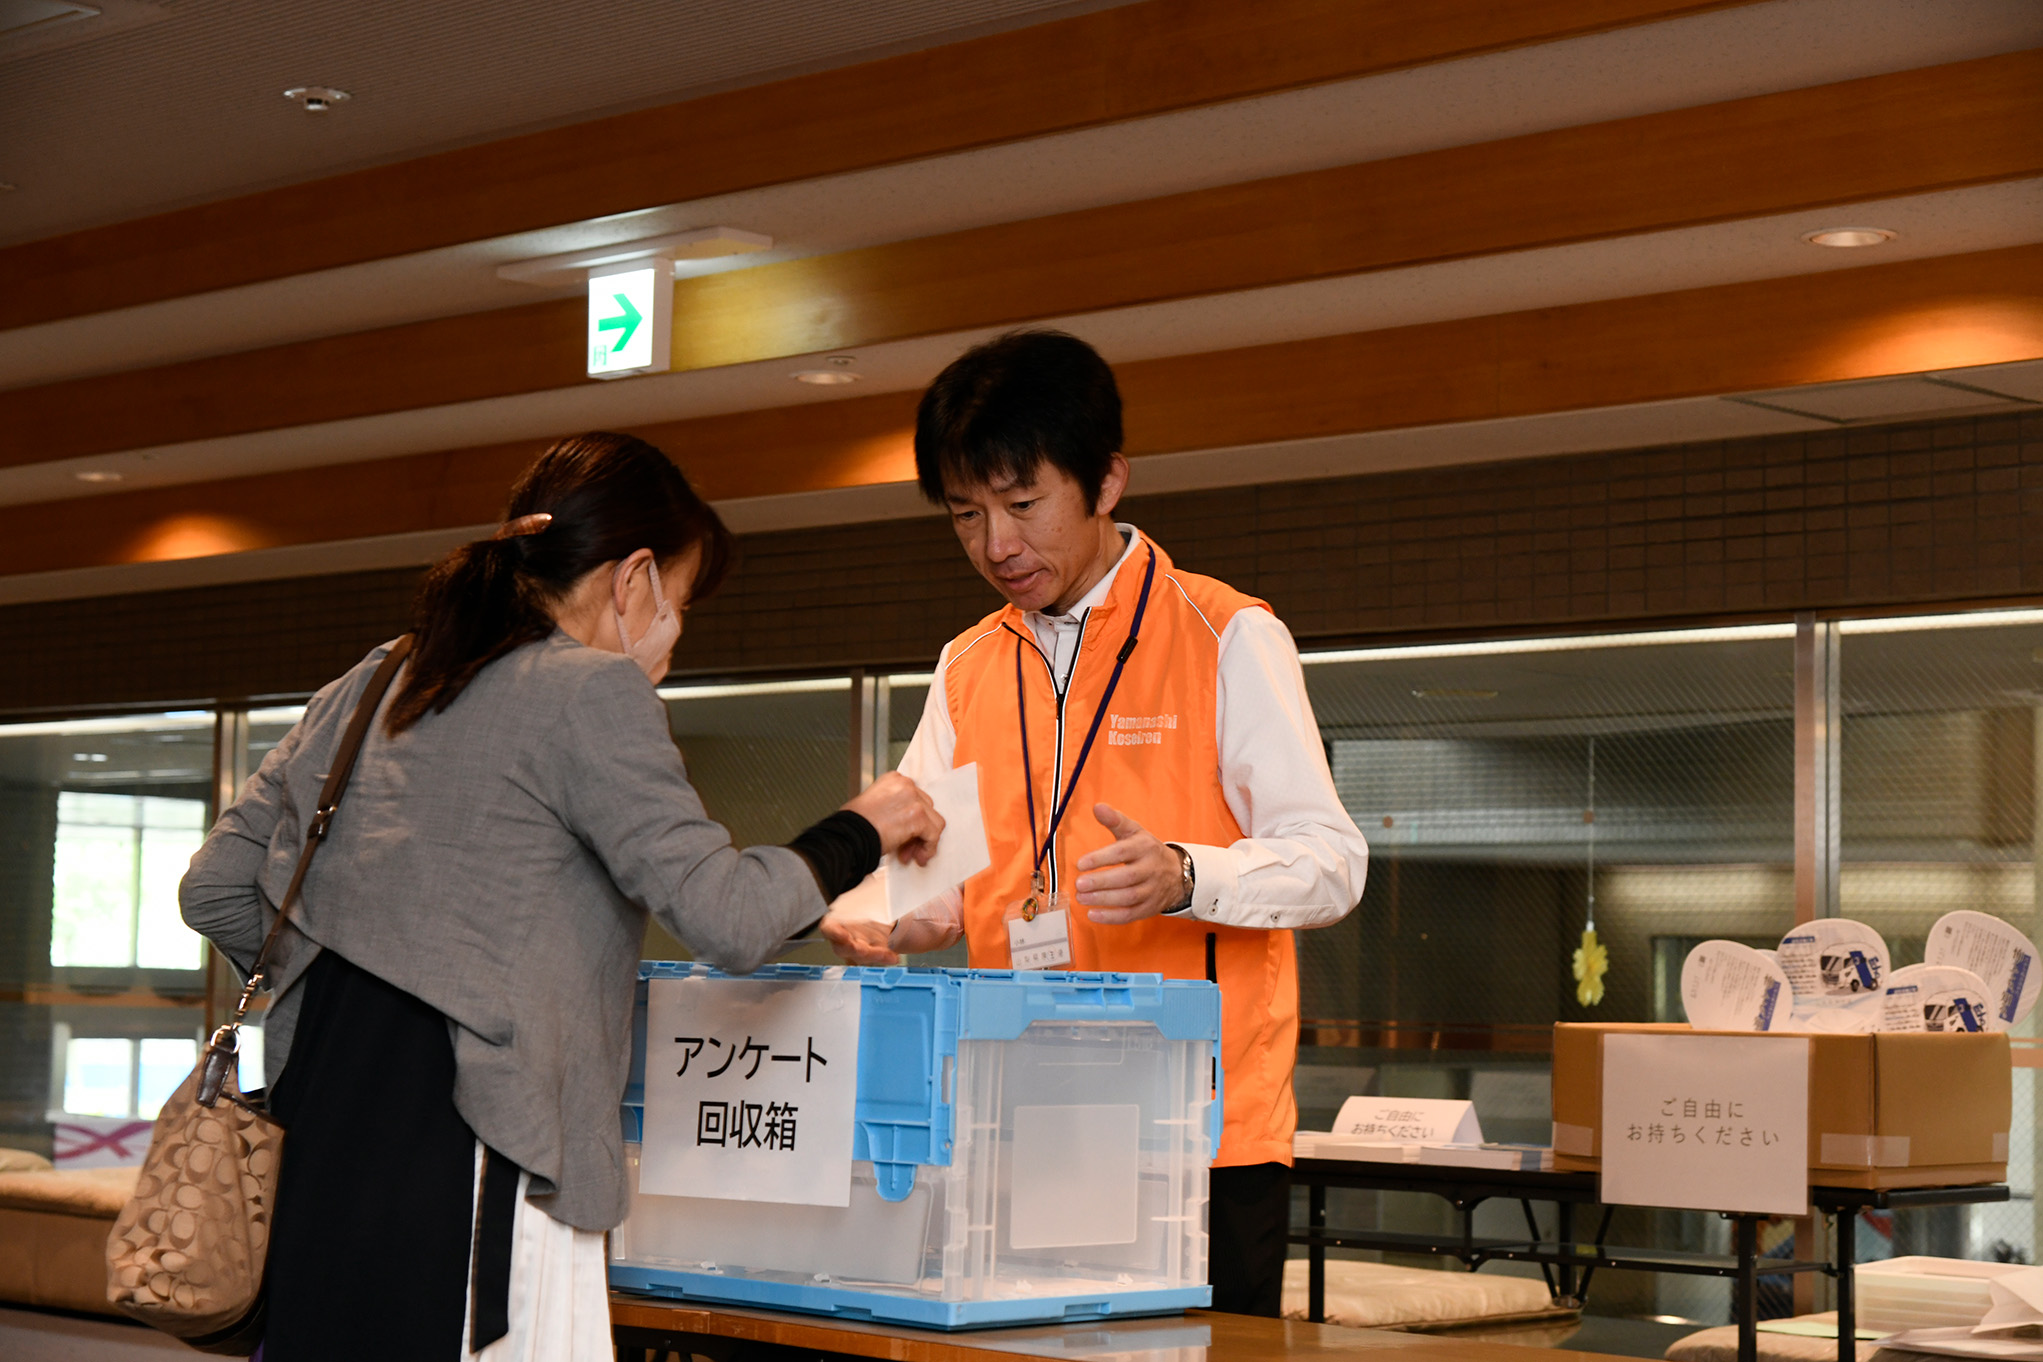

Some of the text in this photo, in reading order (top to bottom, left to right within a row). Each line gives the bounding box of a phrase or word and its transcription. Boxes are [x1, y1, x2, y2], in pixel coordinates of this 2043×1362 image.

[674, 1034, 829, 1083] アンケート
[1374, 1109, 1425, 1123] ご自由に
[1661, 1097, 1745, 1120] ご自由に
[696, 1099, 800, 1152] 回収箱
[1350, 1122, 1435, 1139] お持ちください
[1627, 1123, 1780, 1147] お持ちください
